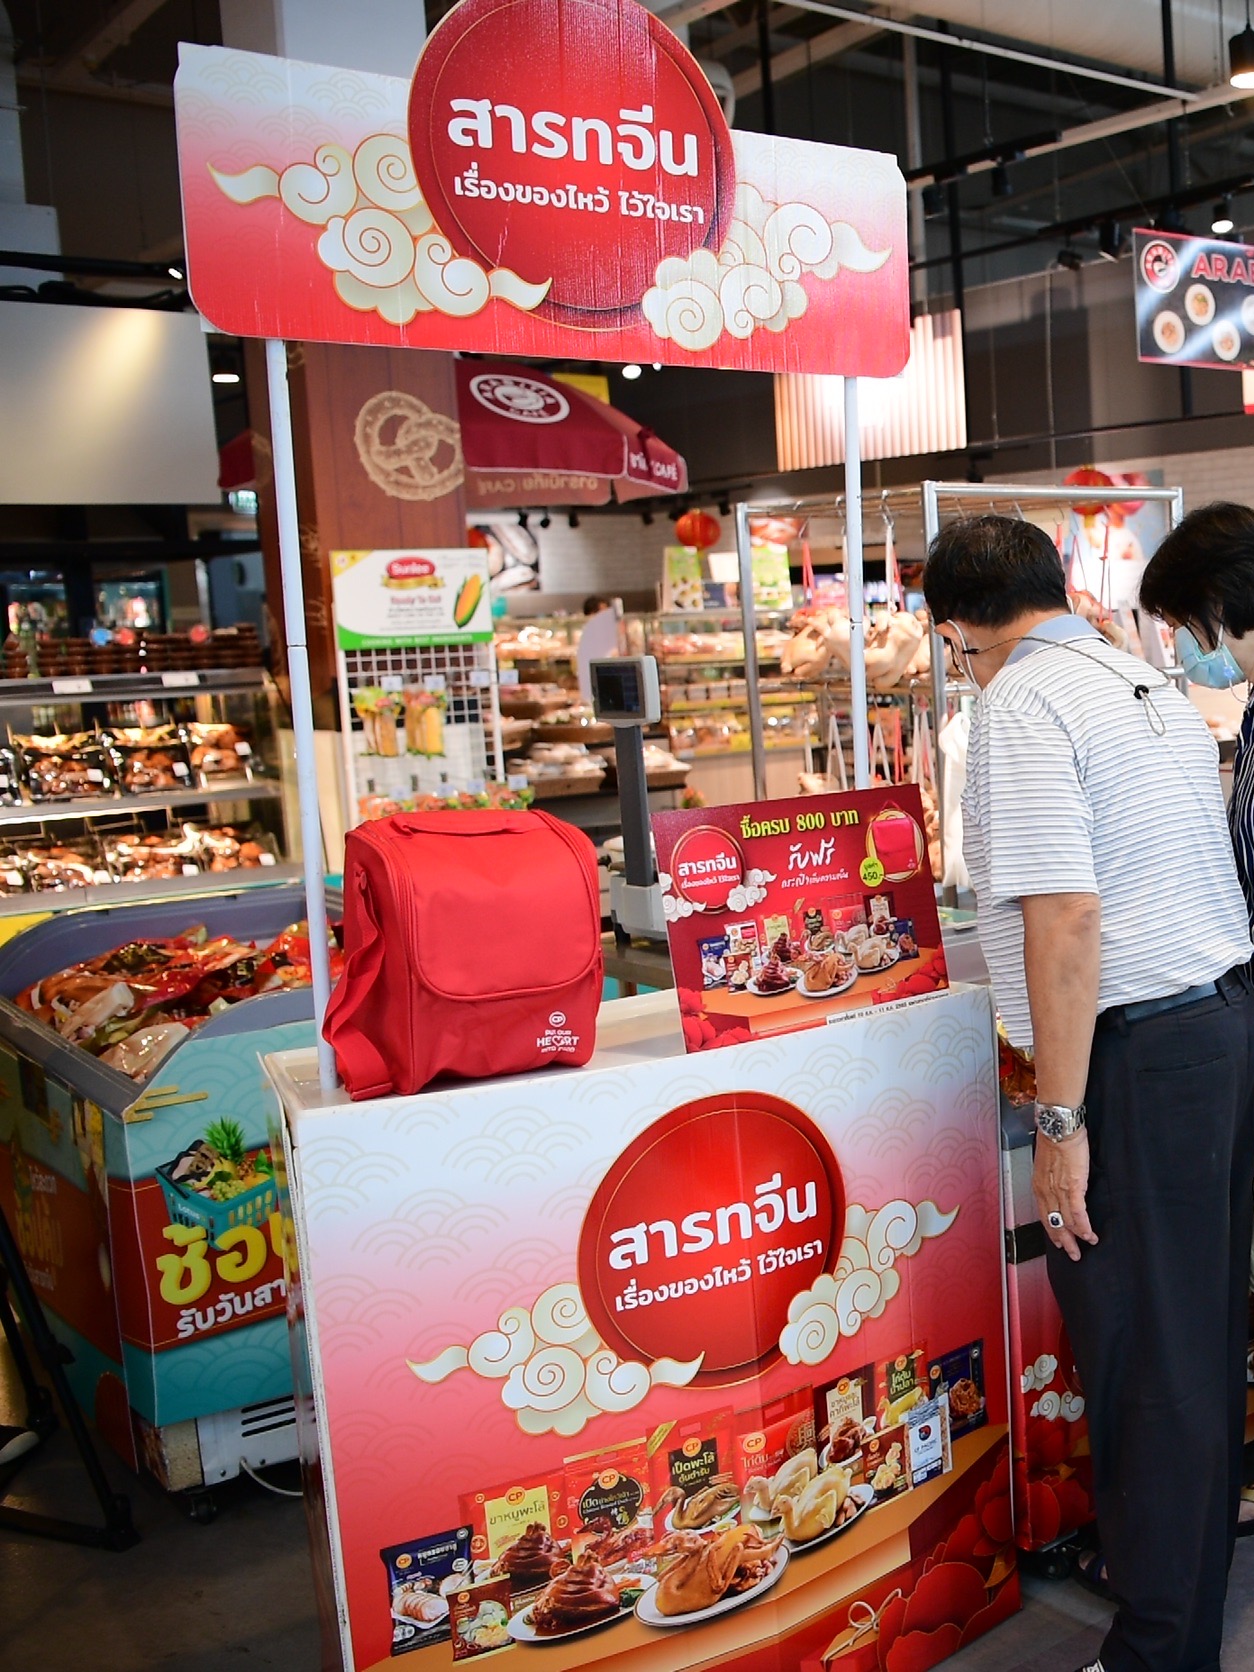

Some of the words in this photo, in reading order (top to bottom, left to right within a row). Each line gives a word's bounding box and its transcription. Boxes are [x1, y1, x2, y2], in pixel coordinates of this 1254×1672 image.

[447, 98, 699, 177] สารทจีน
[453, 161, 611, 213] เรื่องของไหว้
[617, 190, 705, 224] ไว้ใจเรา
[740, 814, 790, 839] ซื้อครบ
[796, 812, 826, 832] 800
[831, 809, 859, 826] บาท
[678, 851, 737, 877] สารทจีน
[788, 836, 836, 871] รับฟรี
[608, 1172, 817, 1270] สารทจีน
[614, 1258, 752, 1312] เรื่องของไหว้
[757, 1239, 823, 1276] ไว้ใจเรา
[176, 1277, 287, 1339] รับวันสา
[686, 1442, 698, 1453] CP
[746, 1437, 762, 1448] CP
[672, 1451, 716, 1476] เป็ดพะโล้
[602, 1473, 616, 1484] CP
[508, 1490, 523, 1502] CP
[489, 1501, 547, 1526] ขาหมูพะโล้
